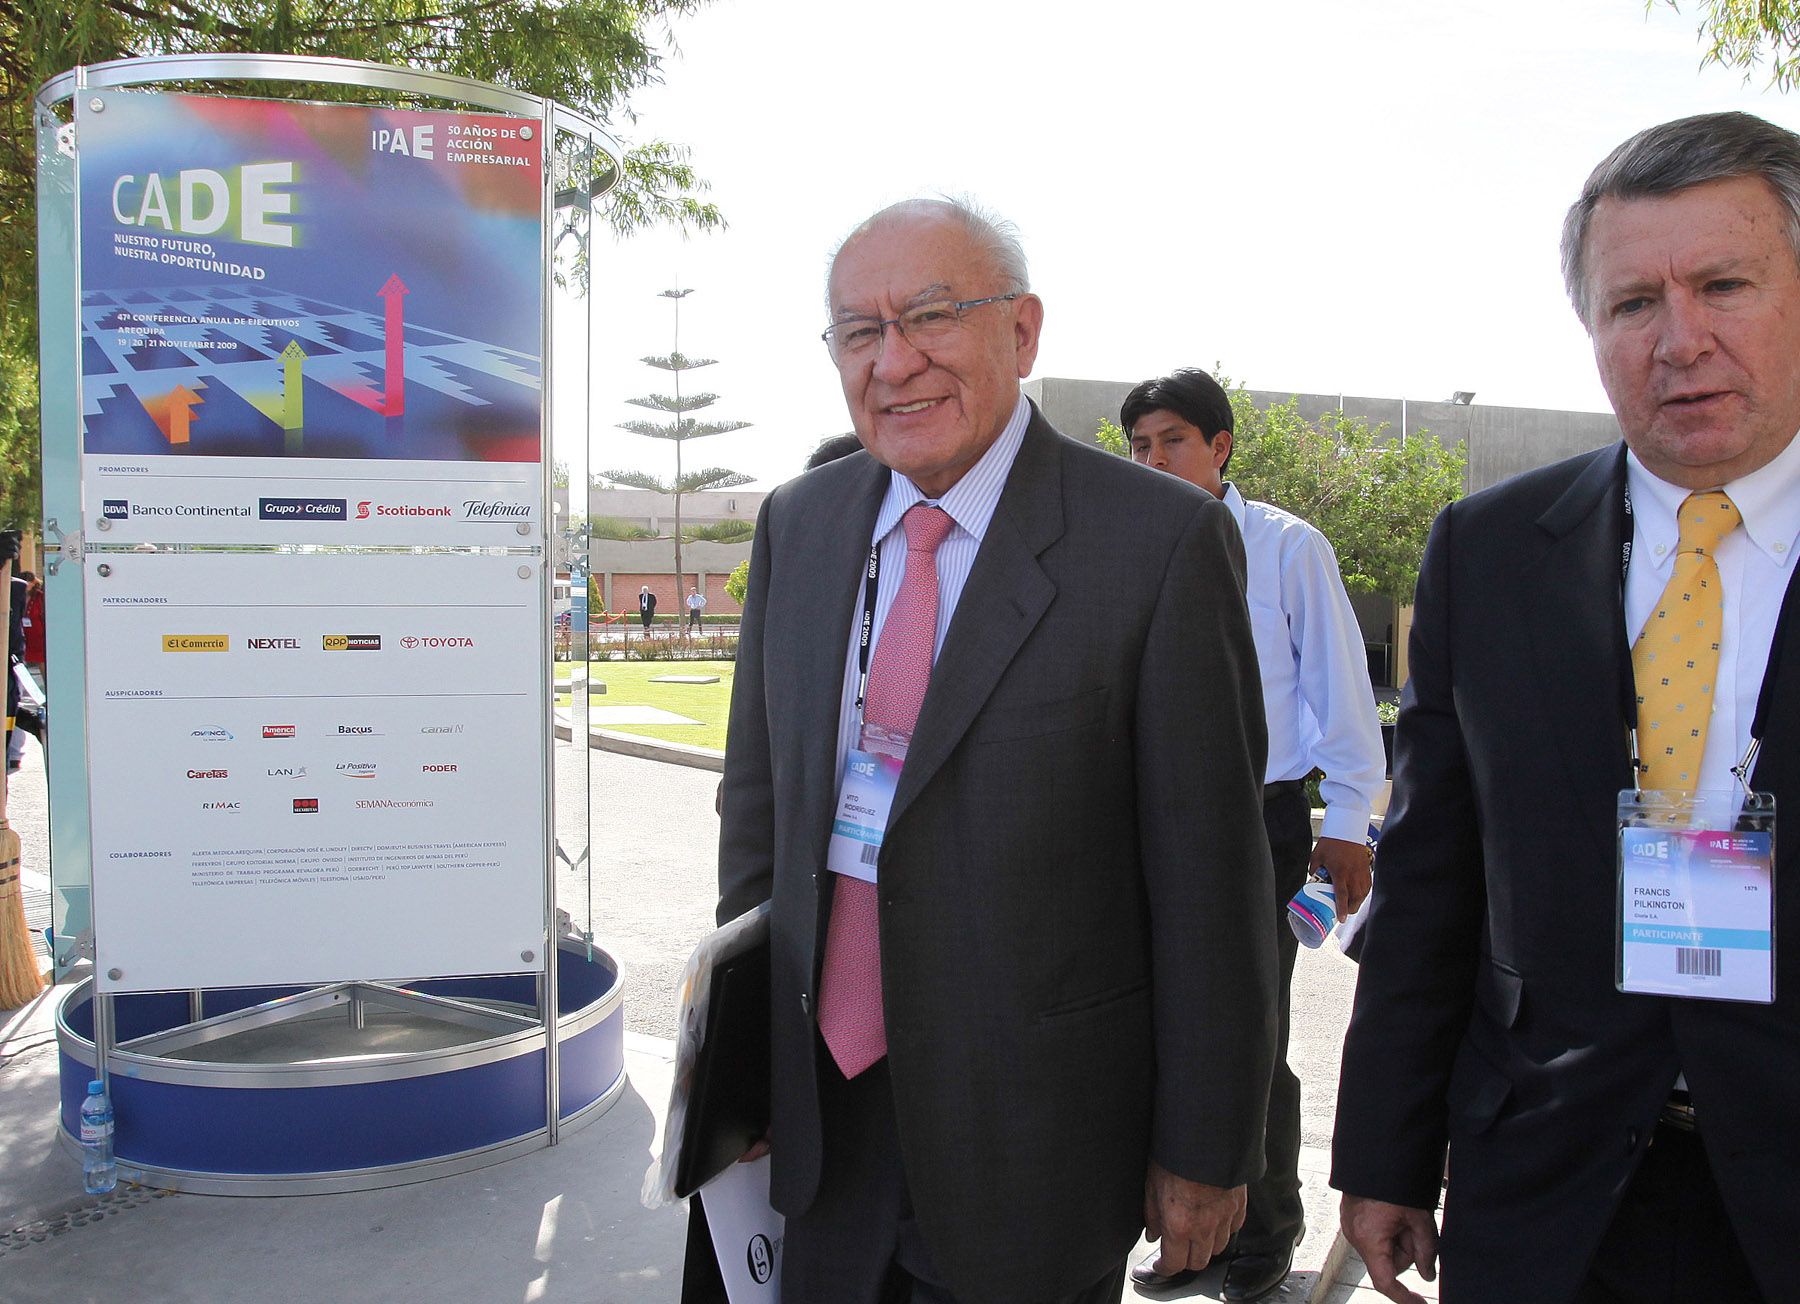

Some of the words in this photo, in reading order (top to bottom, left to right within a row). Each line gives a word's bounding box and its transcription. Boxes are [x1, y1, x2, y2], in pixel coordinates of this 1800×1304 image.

[448, 126, 461, 136] 50
[463, 124, 498, 138] AÑOS
[501, 129, 517, 139] DE
[372, 125, 434, 160] IPAE
[447, 138, 493, 151] ACCIÓN
[447, 152, 531, 167] EMPRESARIAL
[112, 162, 293, 247] CADE
[114, 233, 159, 248] NUESTRO
[161, 239, 217, 258] FUTURO,
[114, 246, 159, 262] NUESTRA
[161, 254, 266, 280] OPORTUNIDAD
[132, 314, 198, 324] CONFERENCIA
[199, 316, 231, 325] ANUAL
[234, 317, 246, 326] DE
[248, 318, 300, 327] EJECUTIVOS
[117, 326, 165, 336] AREQUIPA
[117, 338, 127, 346] 19
[132, 339, 143, 347] 20
[159, 340, 215, 349] NOVIEMBRE
[217, 341, 238, 350] 2009
[104, 505, 128, 515] BBVA
[132, 505, 172, 516] Banco
[174, 505, 251, 517] Continental
[264, 503, 296, 515] Grupo
[305, 503, 341, 514] Crédito
[376, 504, 452, 517] Scotiabank
[868, 559, 878, 579] 2009
[167, 638, 179, 648] El
[181, 638, 225, 648] Comercio
[248, 638, 300, 649] NEXTEL
[348, 638, 380, 646] NOTICIAS
[421, 637, 474, 648] TOYOTA
[105, 689, 163, 697] AUSPICIADORES
[267, 768, 293, 776] LAN
[347, 762, 376, 770] Positiva
[851, 762, 876, 777] CADE
[202, 801, 241, 810] RIMAC
[109, 850, 172, 859] COLABORADORES
[1633, 841, 1668, 859] CADE
[1634, 887, 1671, 897] FRANCIS
[1634, 900, 1685, 910] PILKINGTON
[1632, 928, 1704, 942] PARTICIPANTE
